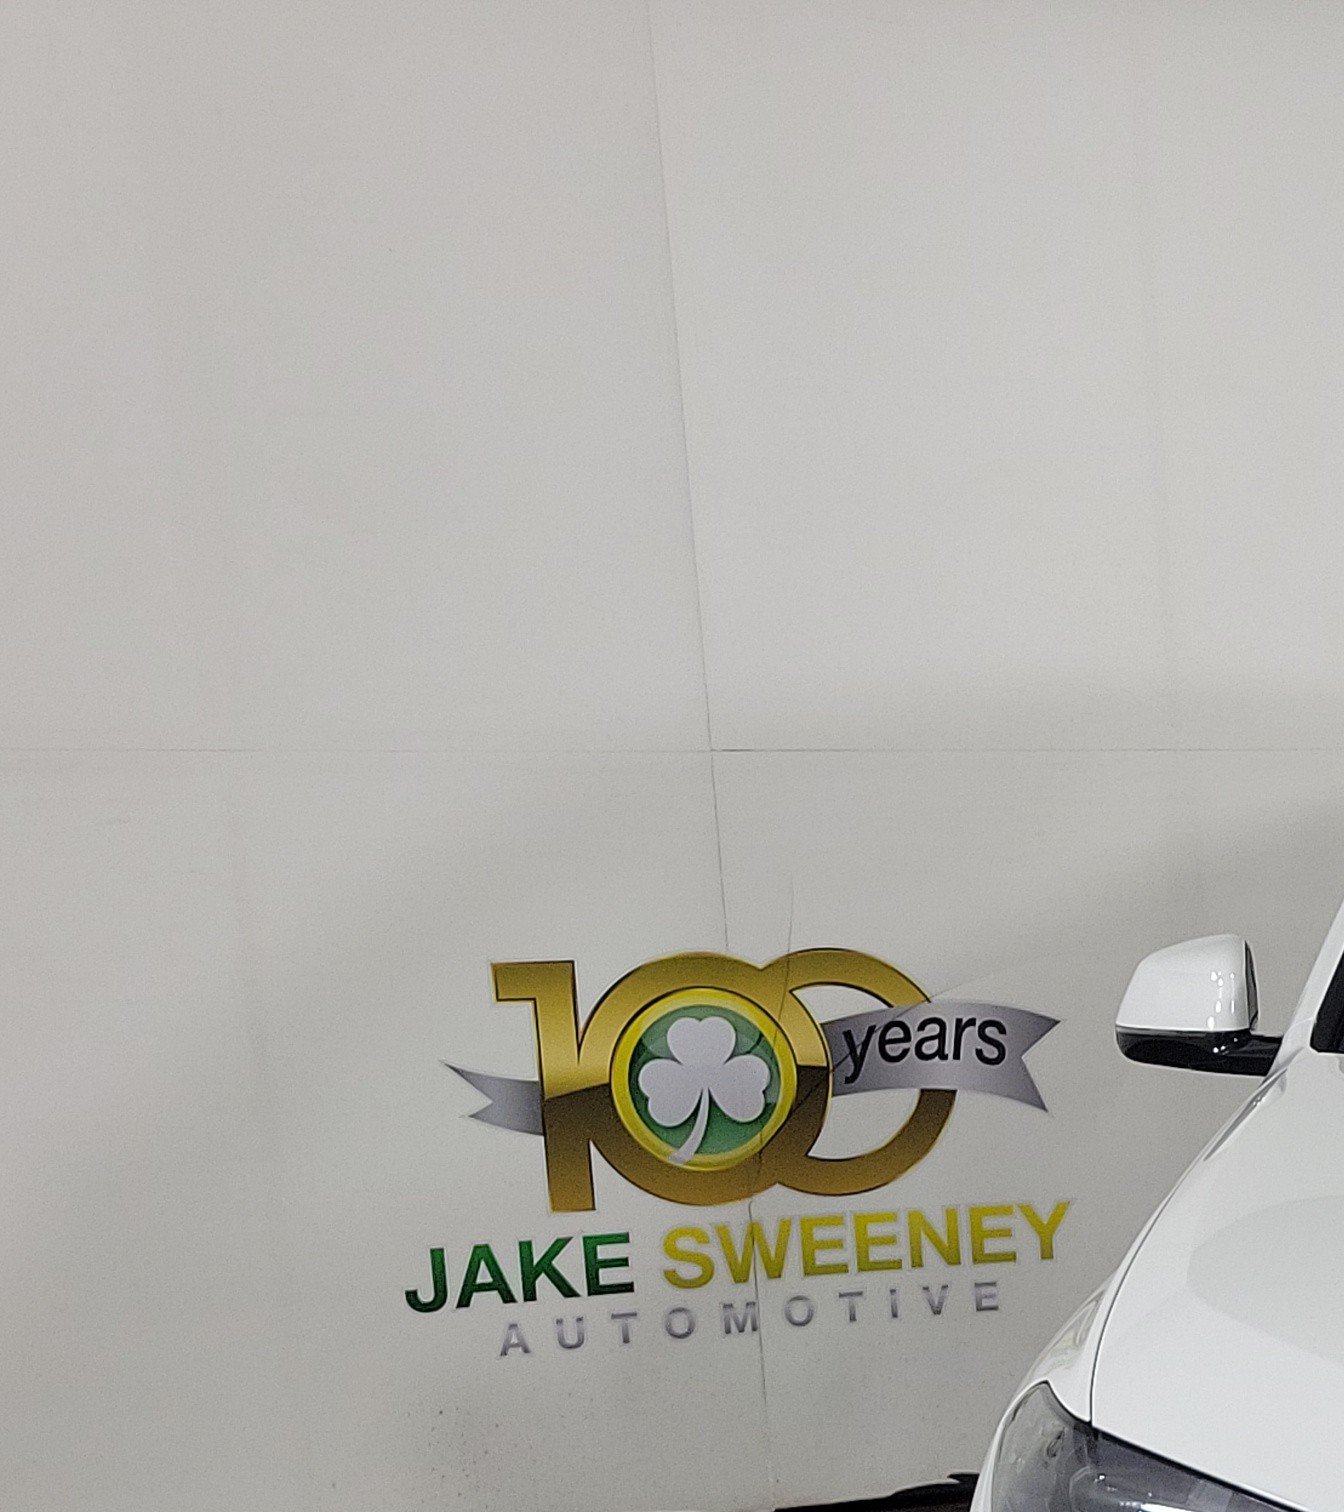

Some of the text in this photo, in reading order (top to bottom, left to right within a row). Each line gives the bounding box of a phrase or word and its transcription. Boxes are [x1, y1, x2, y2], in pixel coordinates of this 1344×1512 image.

[490, 947, 1007, 1213] 100 years
[404, 1200, 1071, 1313] JAKE SWEENEY
[500, 1282, 1000, 1356] AUTOMOTIVE
